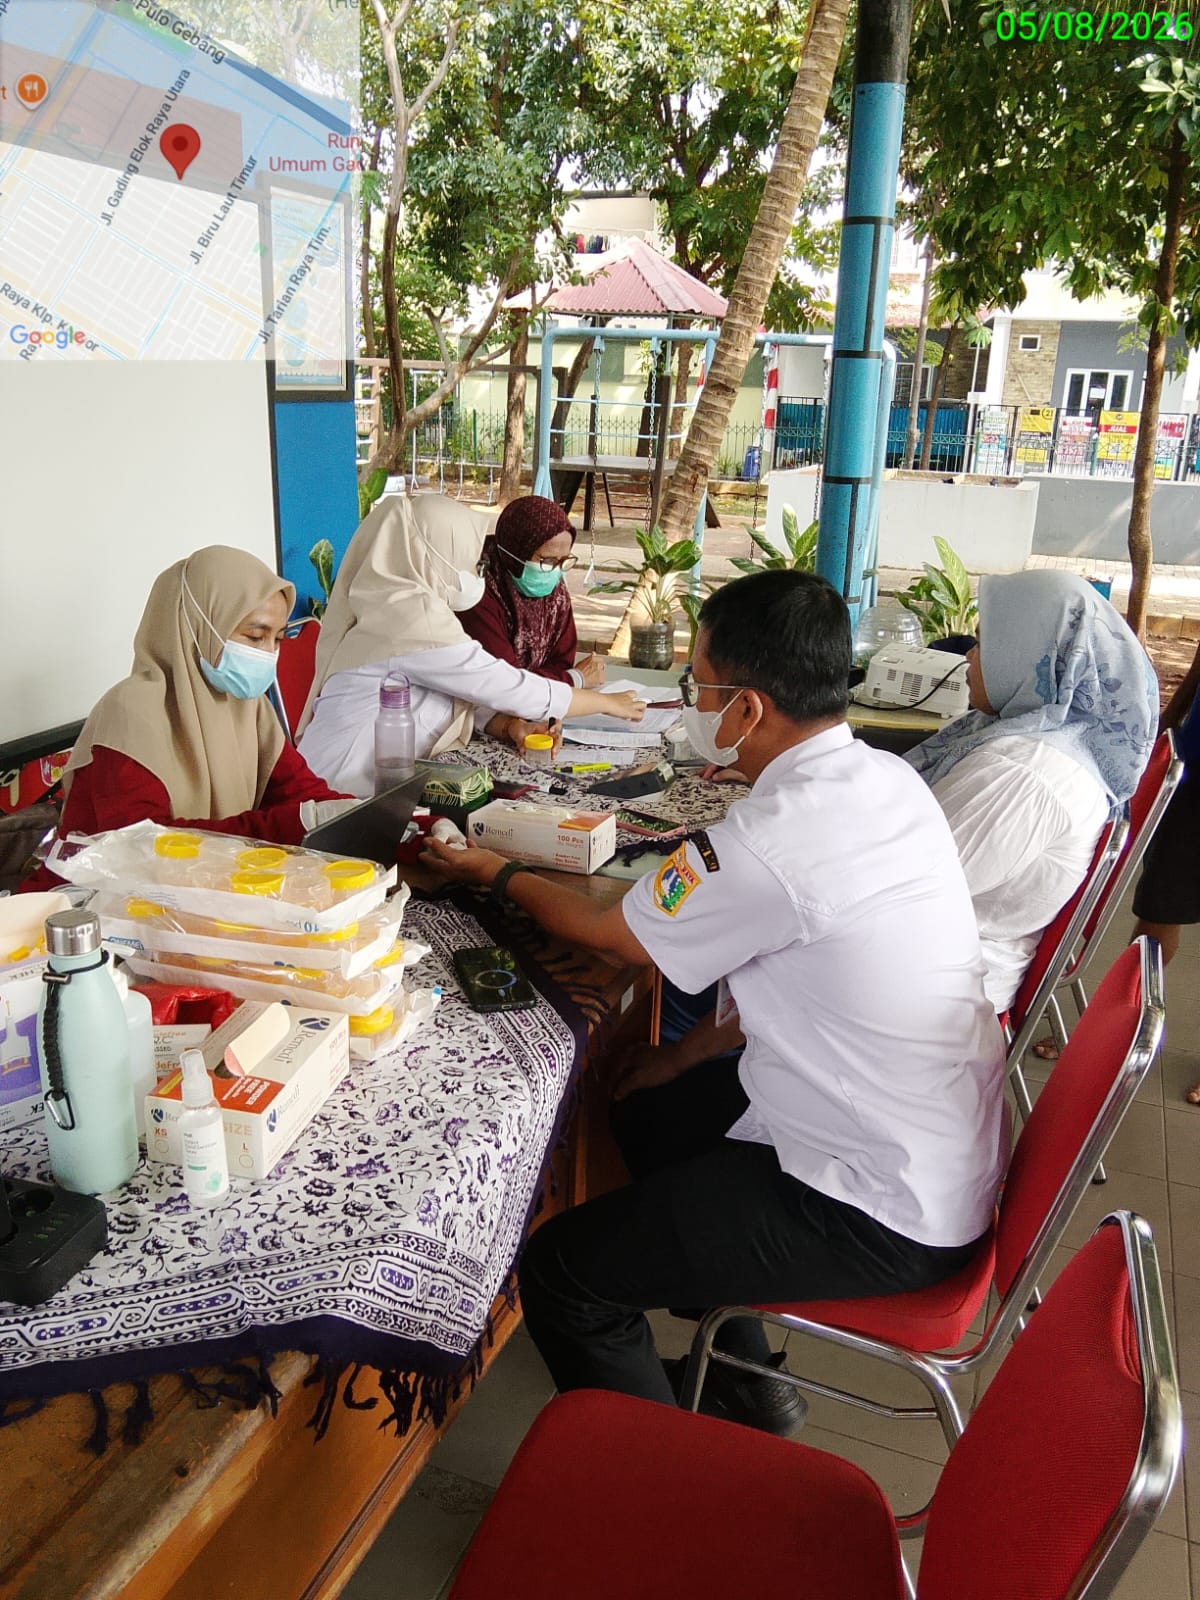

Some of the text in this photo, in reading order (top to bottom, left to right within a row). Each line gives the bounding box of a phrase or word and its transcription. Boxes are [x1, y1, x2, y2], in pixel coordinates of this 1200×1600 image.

[485, 825, 513, 838] Remedi
[274, 1030, 317, 1065] Remedi
[243, 1142, 249, 1151] L
